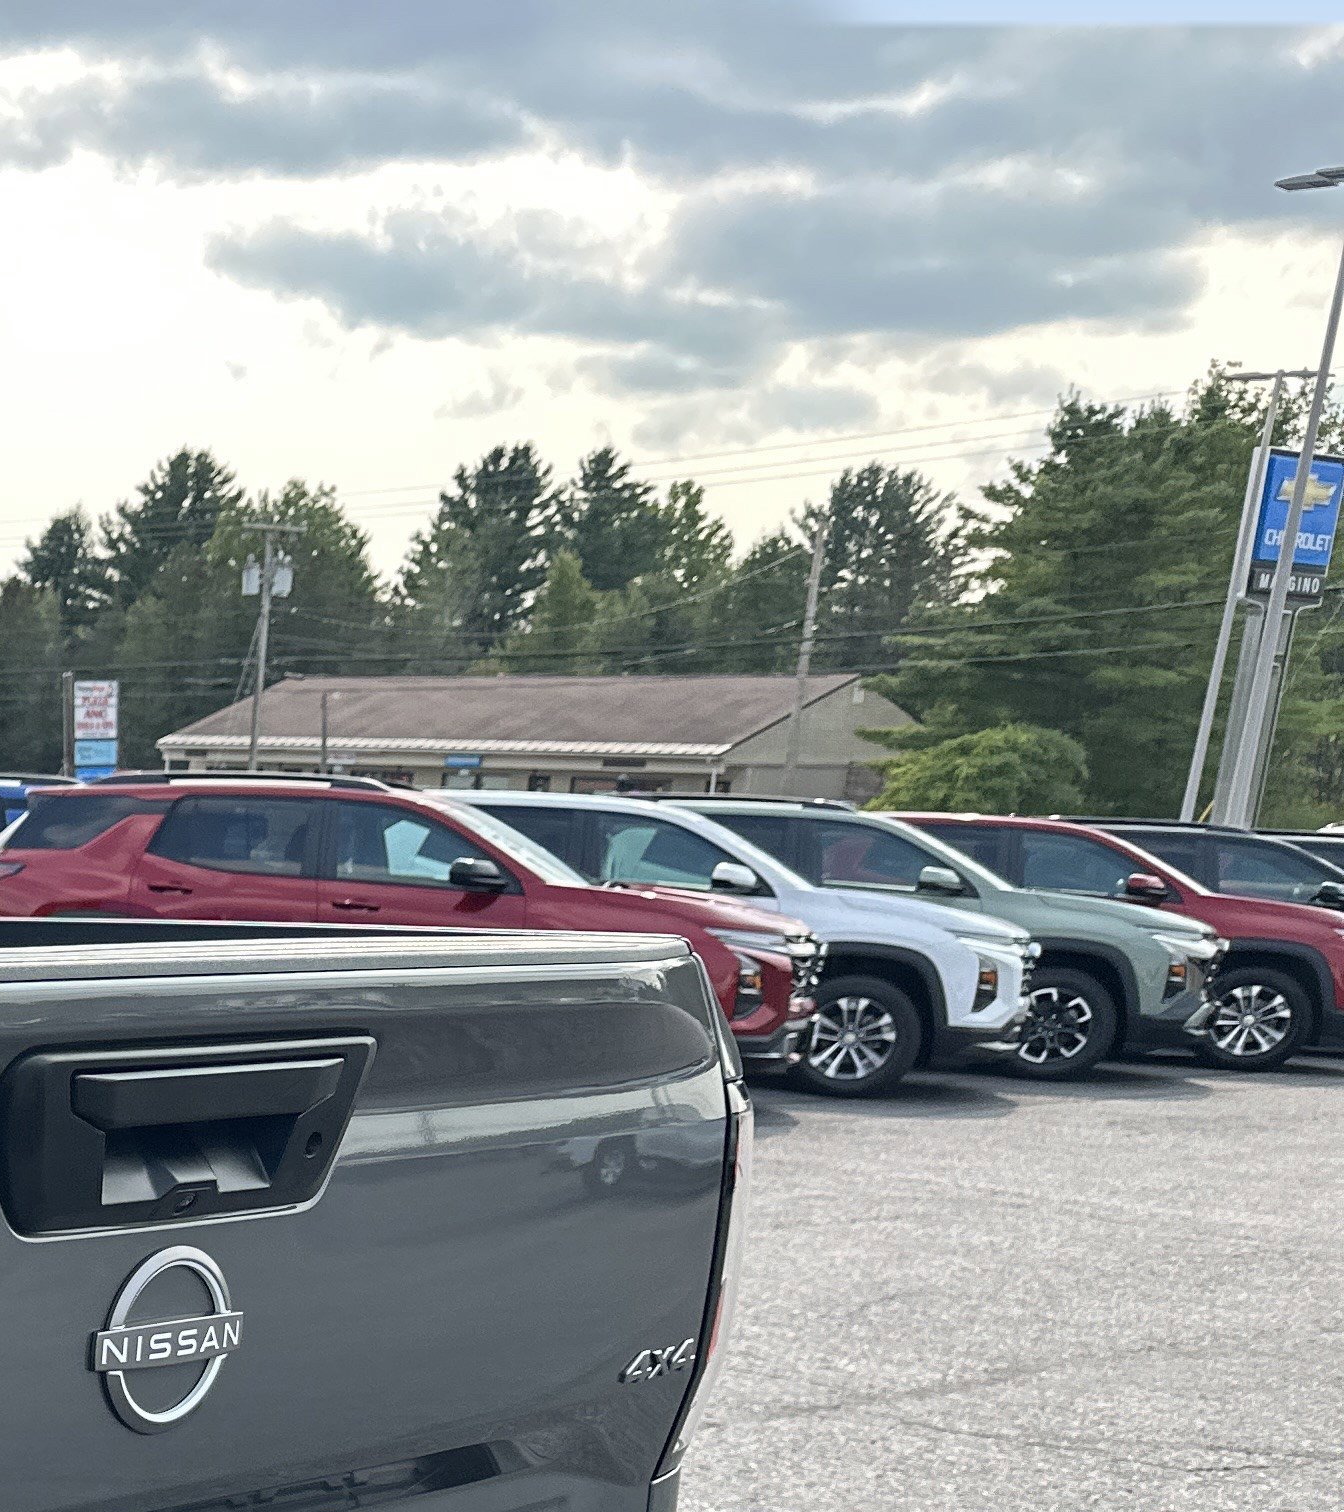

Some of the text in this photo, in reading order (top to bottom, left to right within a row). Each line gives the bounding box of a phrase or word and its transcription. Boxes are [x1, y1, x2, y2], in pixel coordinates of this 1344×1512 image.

[1264, 528, 1331, 551] CHROLET
[1258, 573, 1321, 594] MGINO
[100, 1319, 241, 1365] NISSAN
